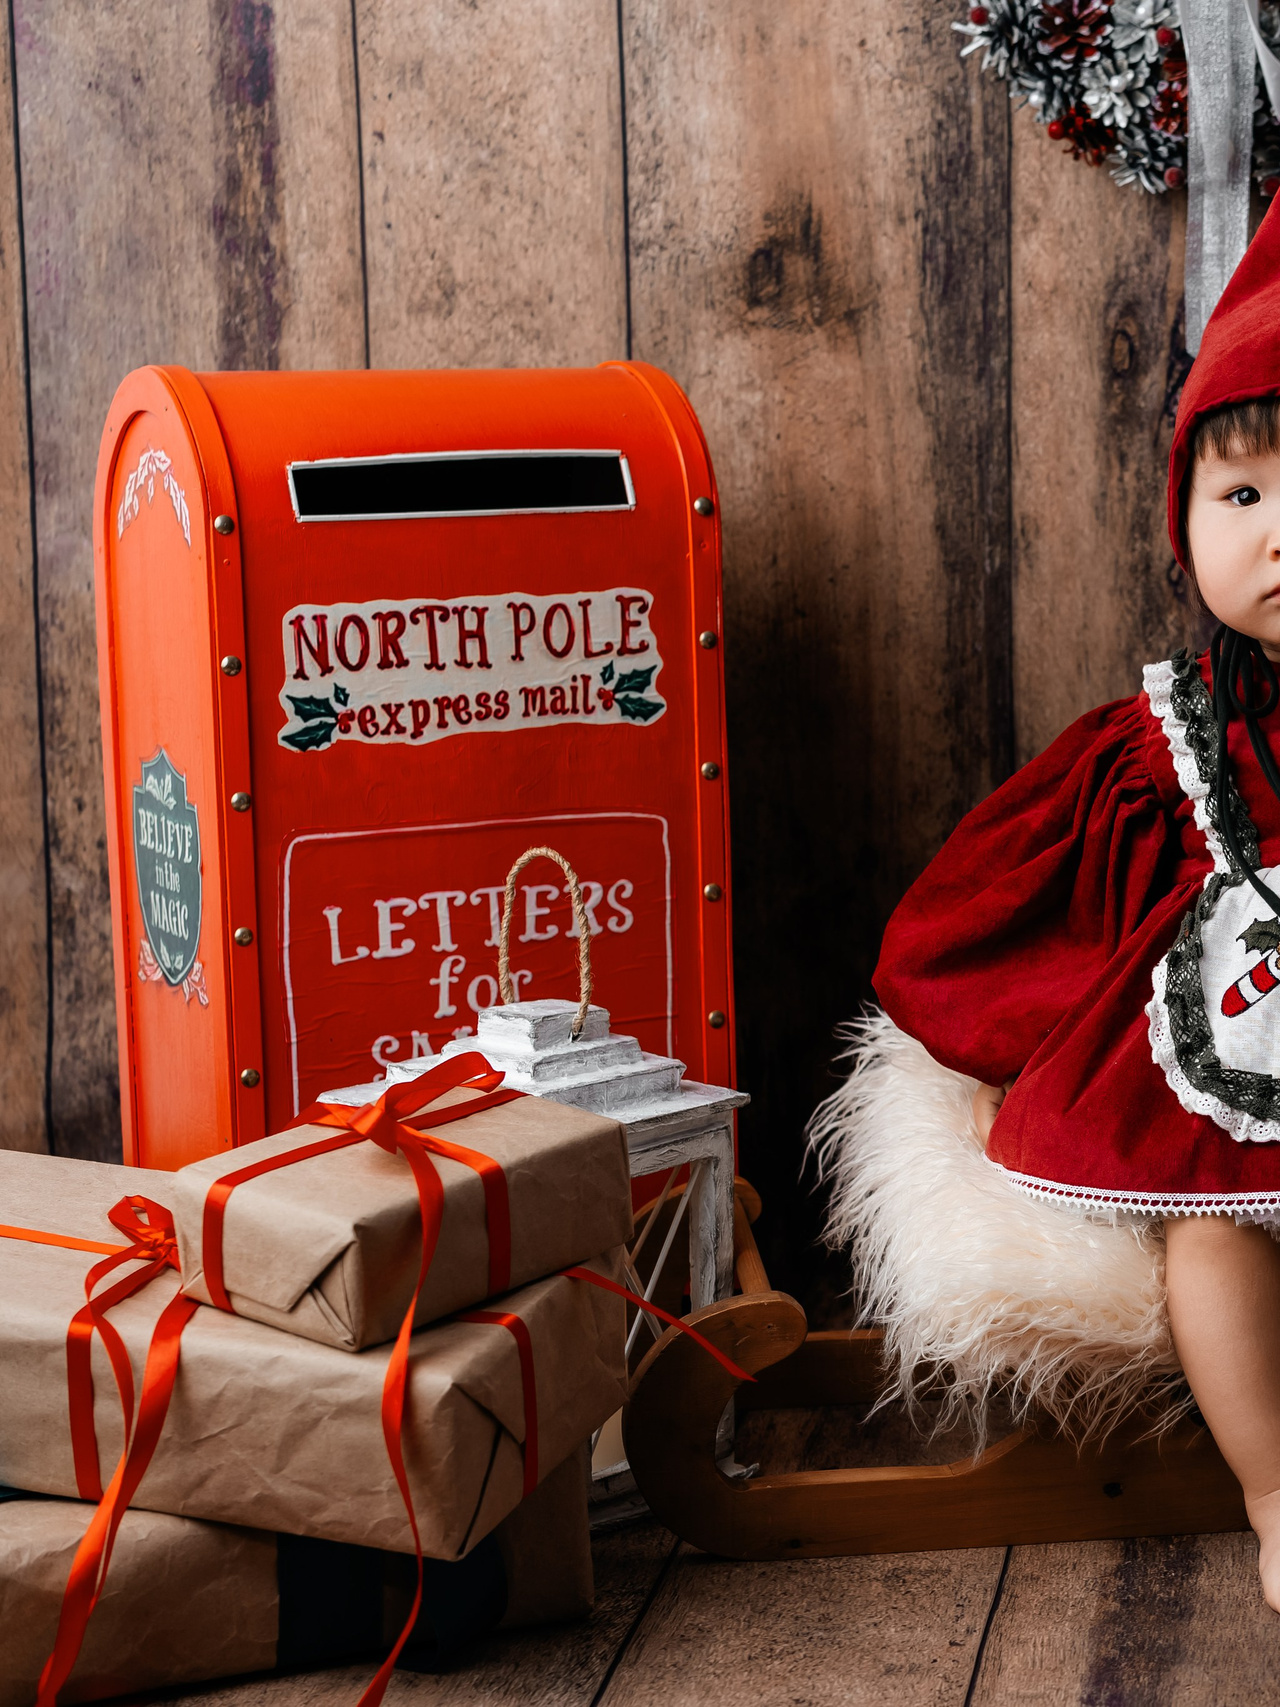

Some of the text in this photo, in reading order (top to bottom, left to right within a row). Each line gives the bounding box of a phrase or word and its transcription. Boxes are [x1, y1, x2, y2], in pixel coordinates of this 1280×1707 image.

[288, 594, 650, 681] NORTH POLE
[357, 673, 597, 740] express mail
[138, 807, 193, 864] BELIEVE
[150, 891, 190, 941] MAGIC
[322, 878, 635, 967] LETTERS
[428, 954, 533, 1020] for
